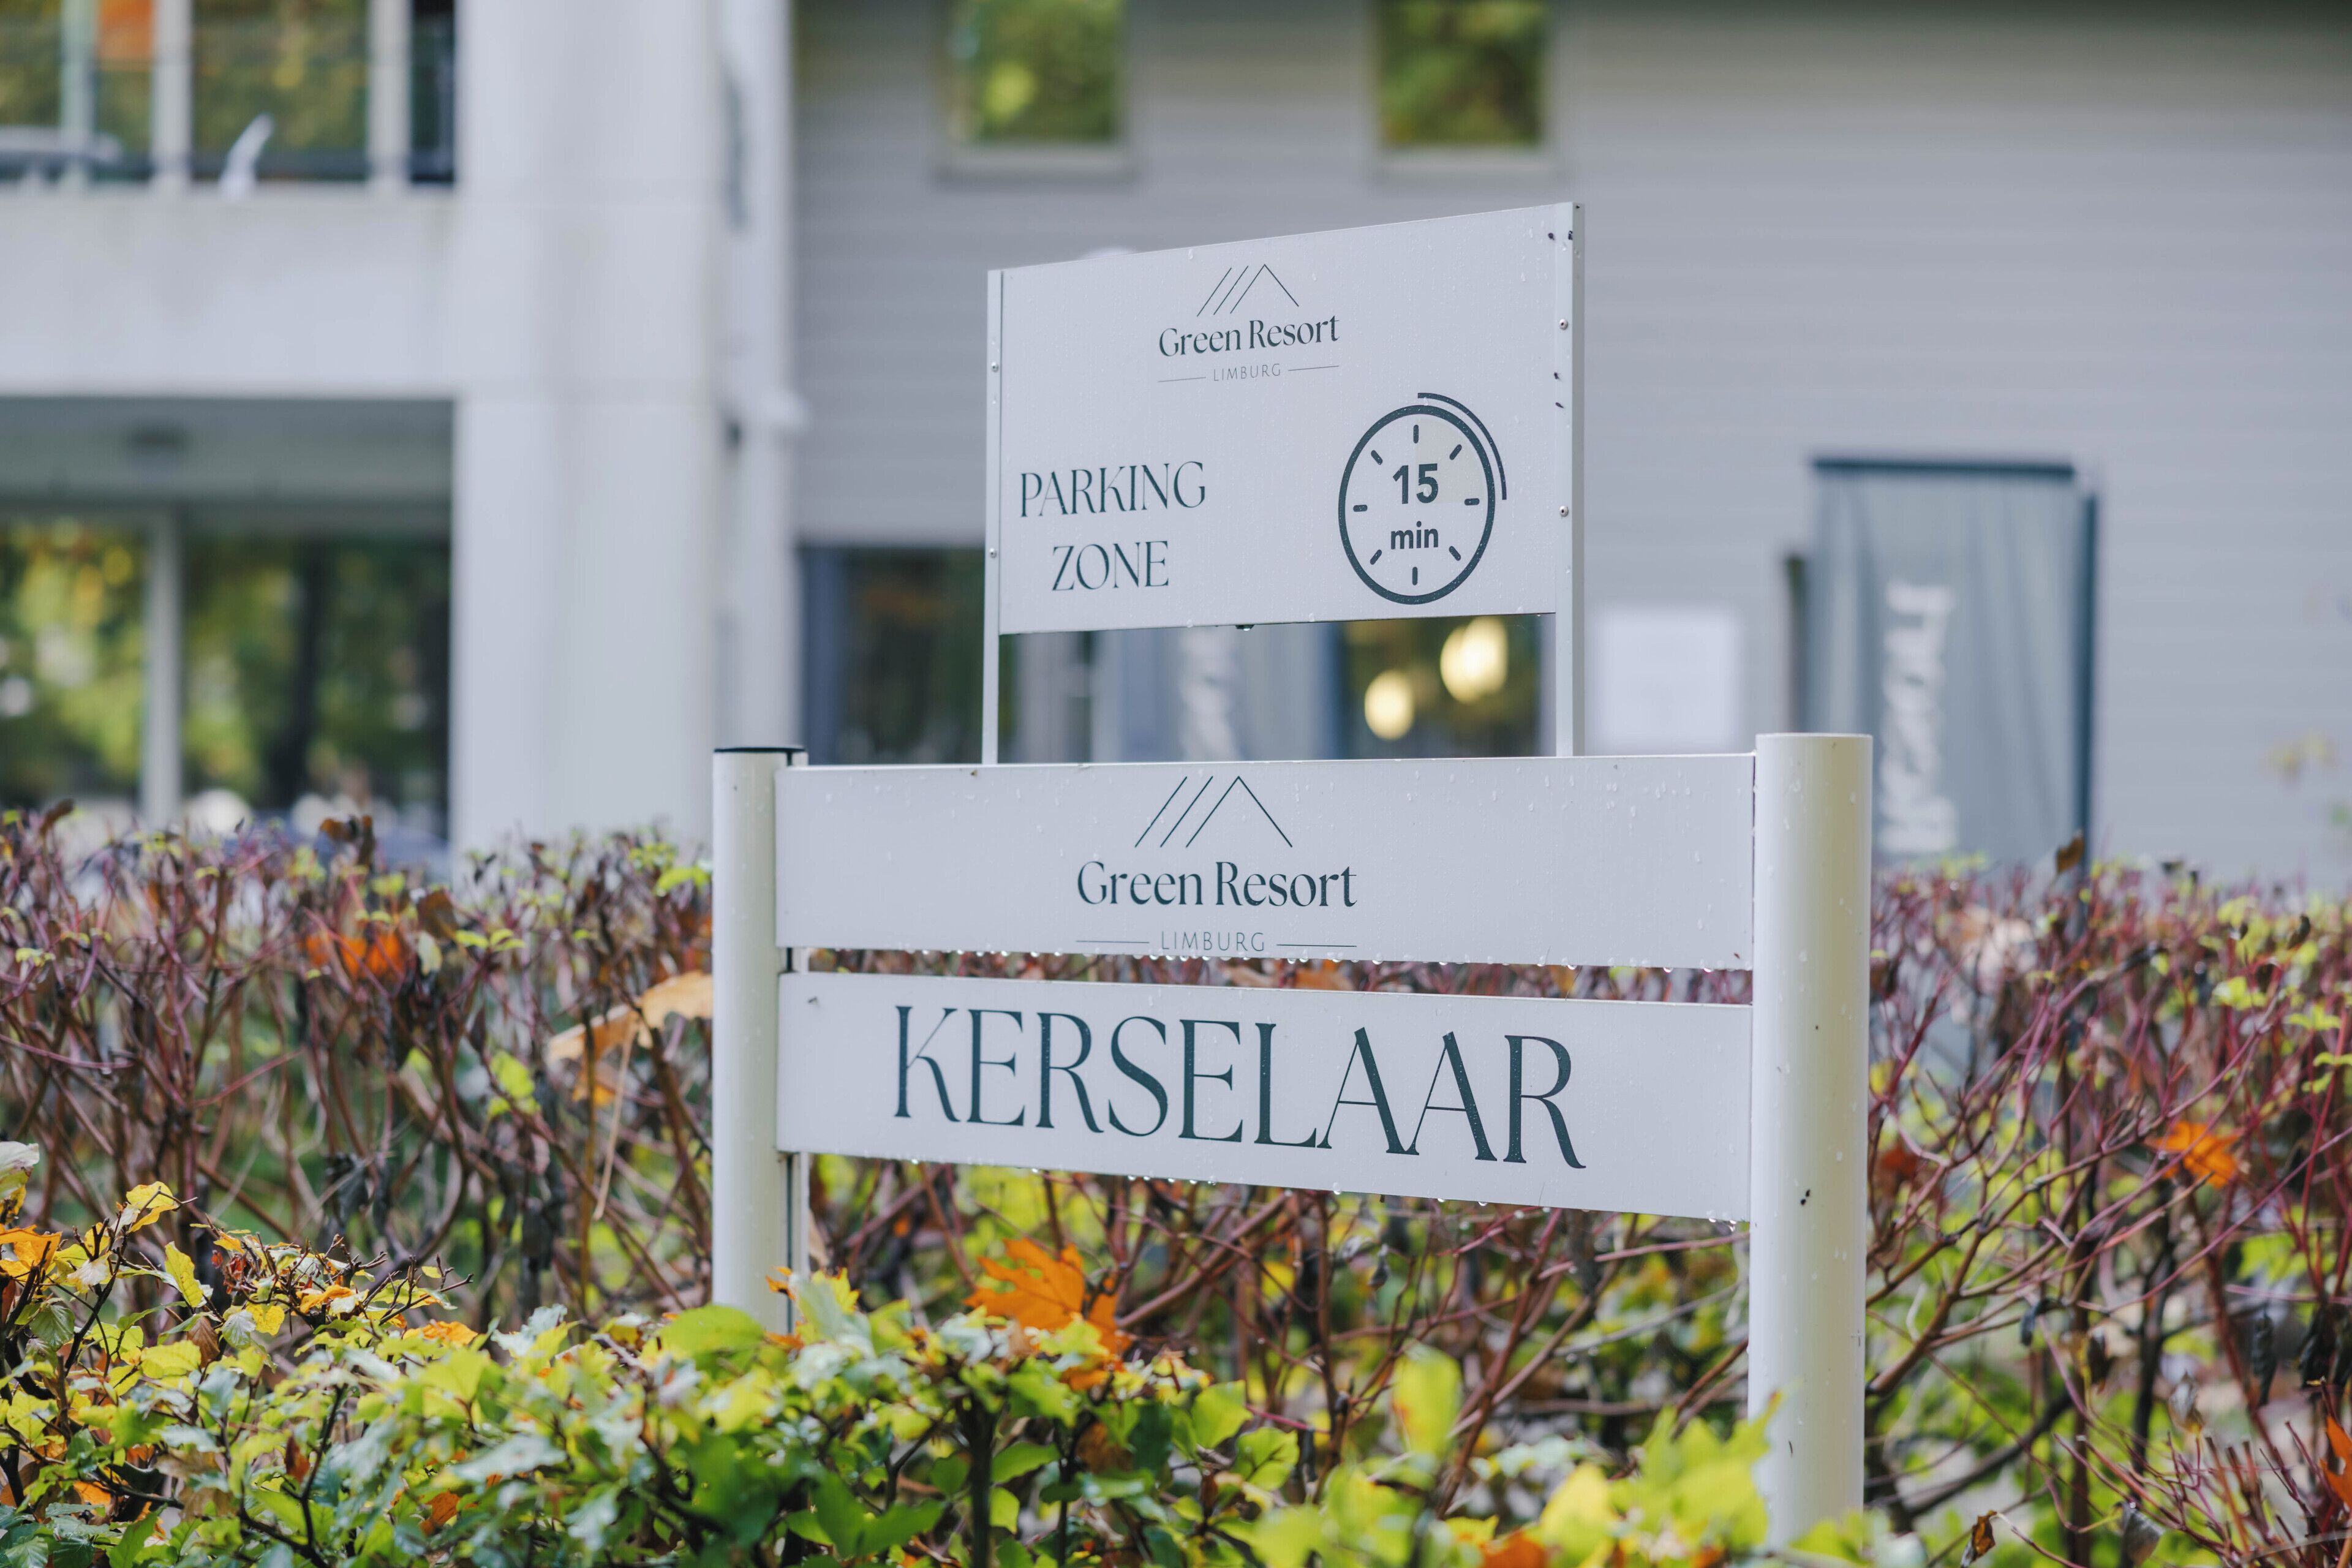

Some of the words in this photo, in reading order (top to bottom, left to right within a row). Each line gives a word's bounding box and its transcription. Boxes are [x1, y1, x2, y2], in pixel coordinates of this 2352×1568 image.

[1158, 327, 1242, 358] Green
[1249, 314, 1340, 349] Resort
[1213, 363, 1281, 382] LIMBURG
[1020, 461, 1206, 518] PARKING
[1392, 462, 1439, 505] 15
[1390, 521, 1439, 550] min
[1052, 540, 1170, 592] ZONE
[1077, 860, 1204, 906] Green
[1215, 861, 1358, 908] Resort
[1160, 930, 1266, 952] LIMBURG
[894, 1005, 1587, 1169] KERSELAAR
